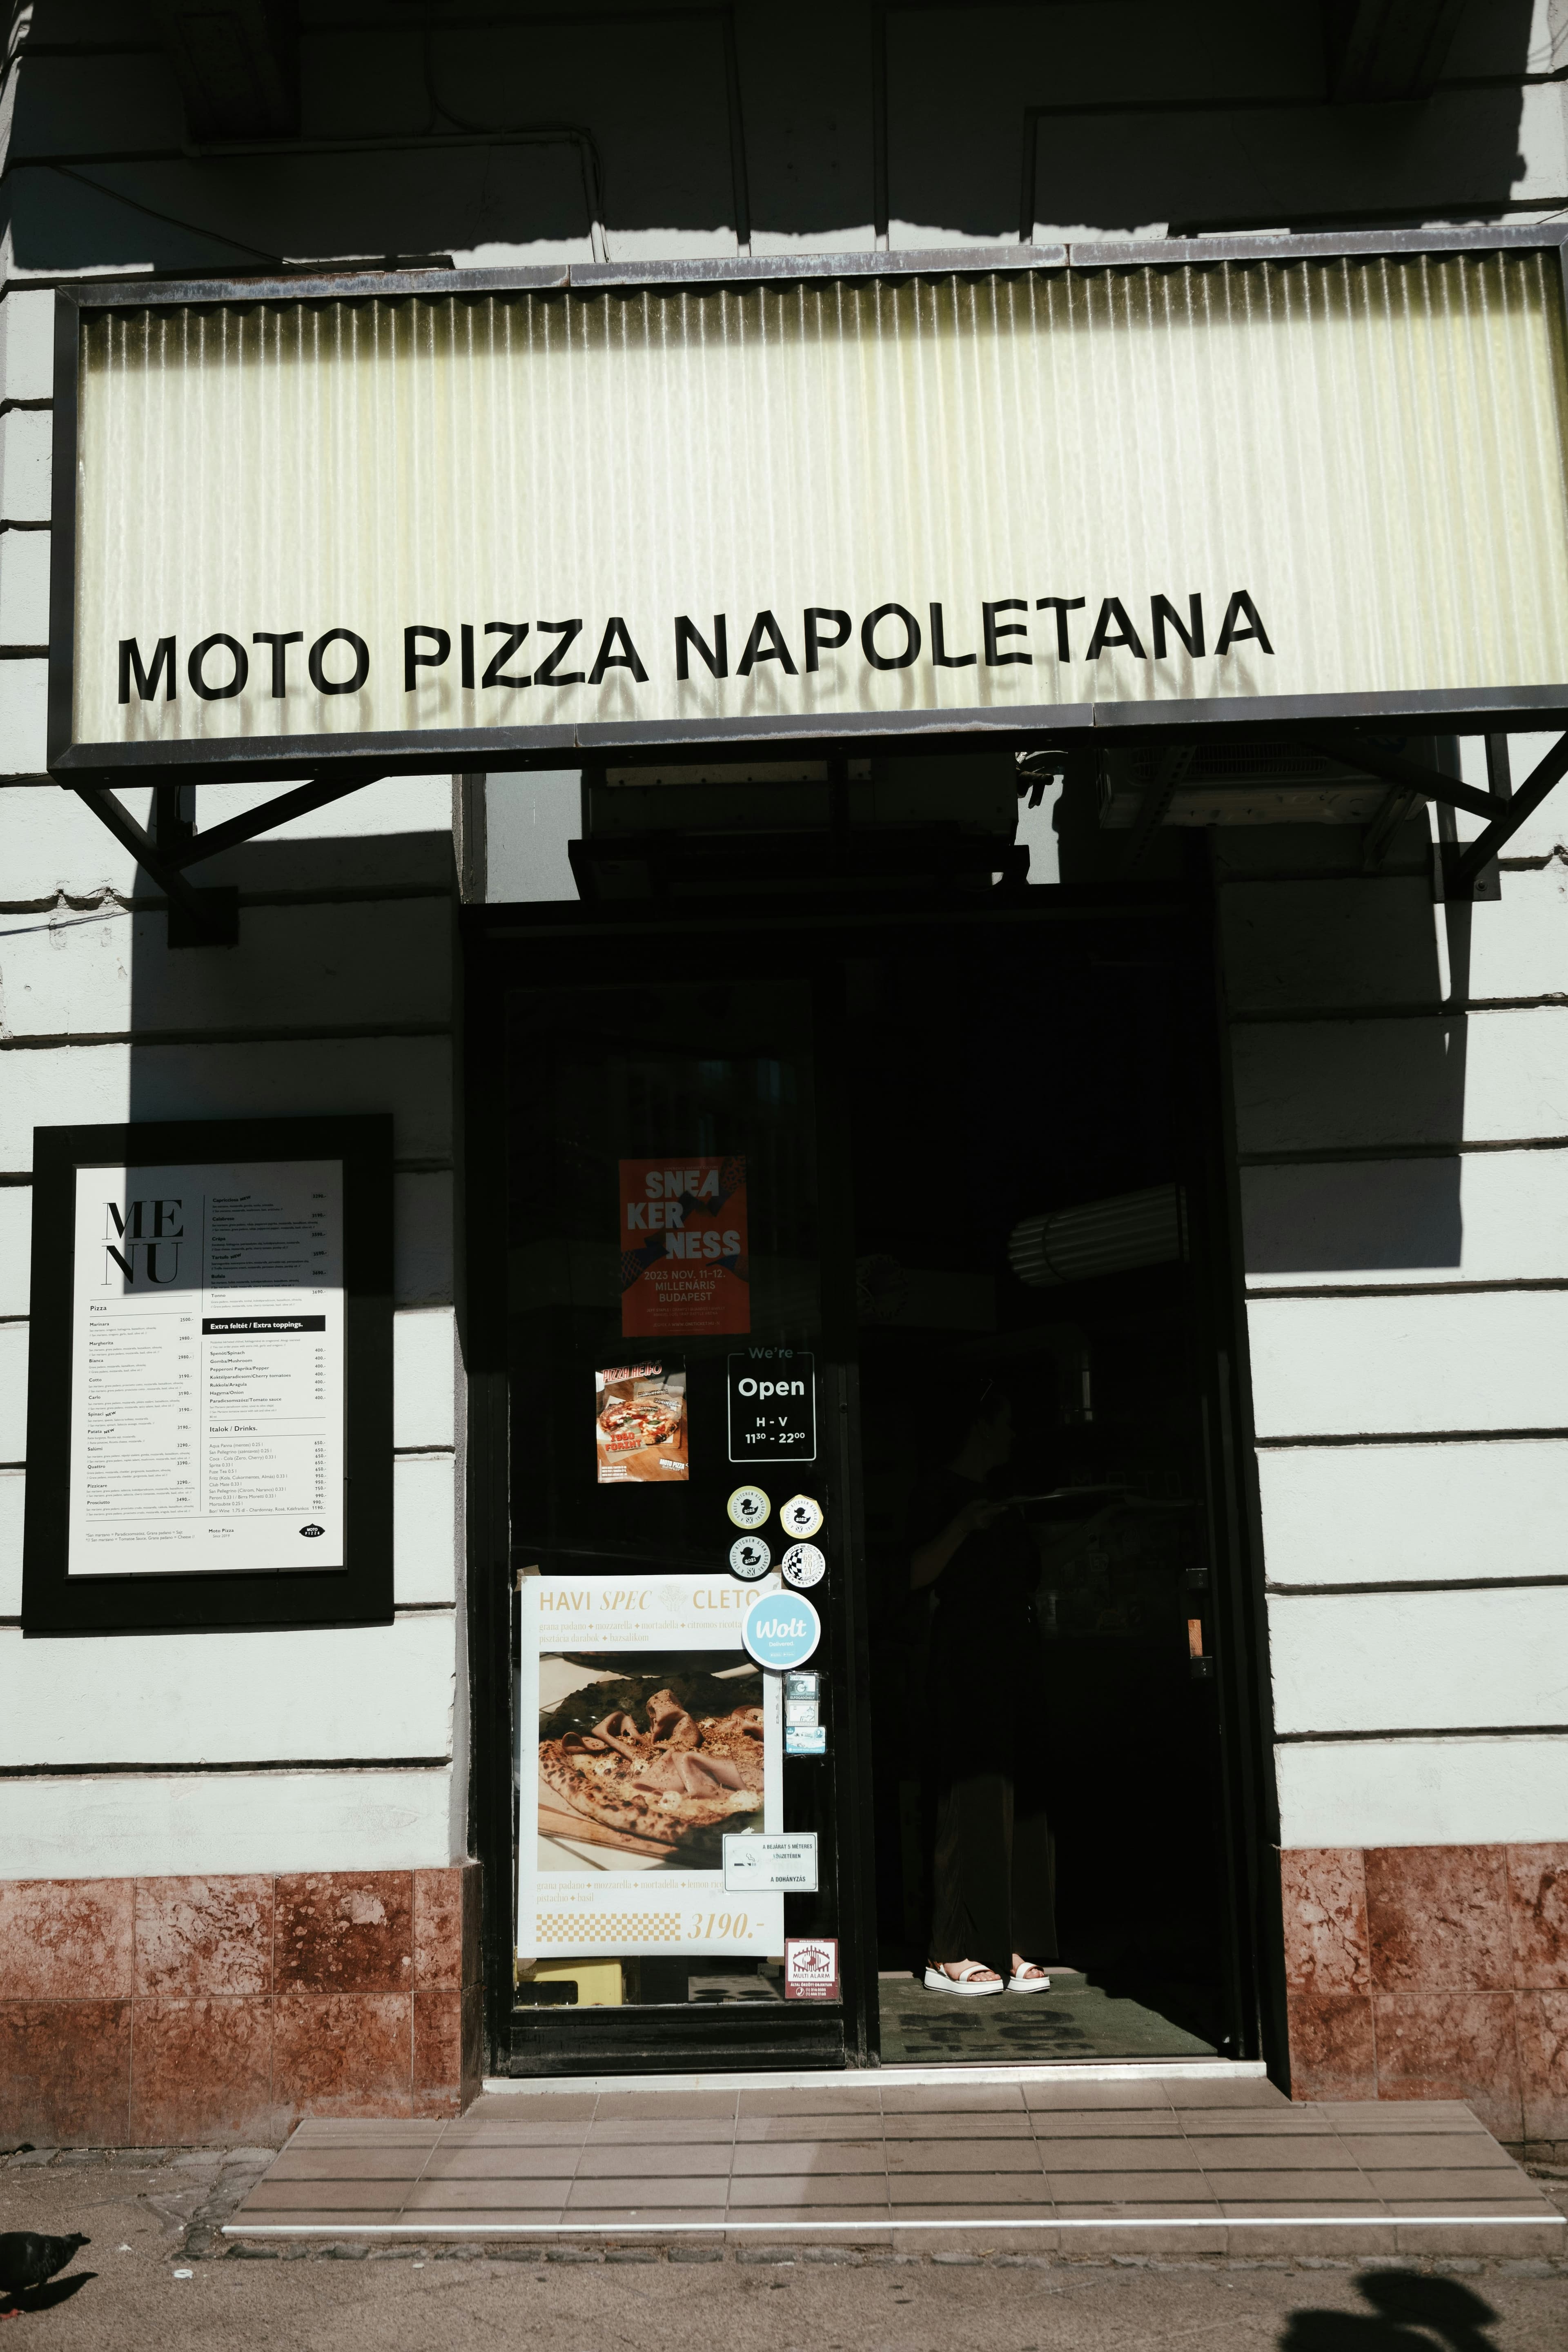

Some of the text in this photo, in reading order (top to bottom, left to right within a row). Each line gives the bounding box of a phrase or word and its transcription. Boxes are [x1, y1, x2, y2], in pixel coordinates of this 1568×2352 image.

[118, 590, 1275, 704] MOTO PIZZA NAPOLETANA
[645, 1170, 719, 1198] SNEA
[102, 1200, 183, 1240] ME
[627, 1202, 685, 1230] KER
[666, 1230, 741, 1259] NESS
[101, 1243, 183, 1285] NU
[644, 1271, 668, 1280] 2023
[672, 1270, 696, 1279] NOV.
[655, 1280, 715, 1291] MILLENÁRIS
[659, 1292, 712, 1302] BUDAPEST
[601, 1367, 630, 1383] PIZZA
[738, 1378, 804, 1400] Open
[757, 1417, 765, 1427] H
[778, 1417, 788, 1426] V
[605, 1440, 642, 1451] FORINT
[539, 1591, 591, 1611] HAVI
[600, 1590, 653, 1611] SPEC
[539, 1620, 742, 1633] grana padano mozzarella mortadella citromos ricotta
[756, 1618, 806, 1638] Wolt
[539, 1633, 649, 1644] pisztácia darabok bazsalikom
[687, 1913, 765, 1939] 3190.-
